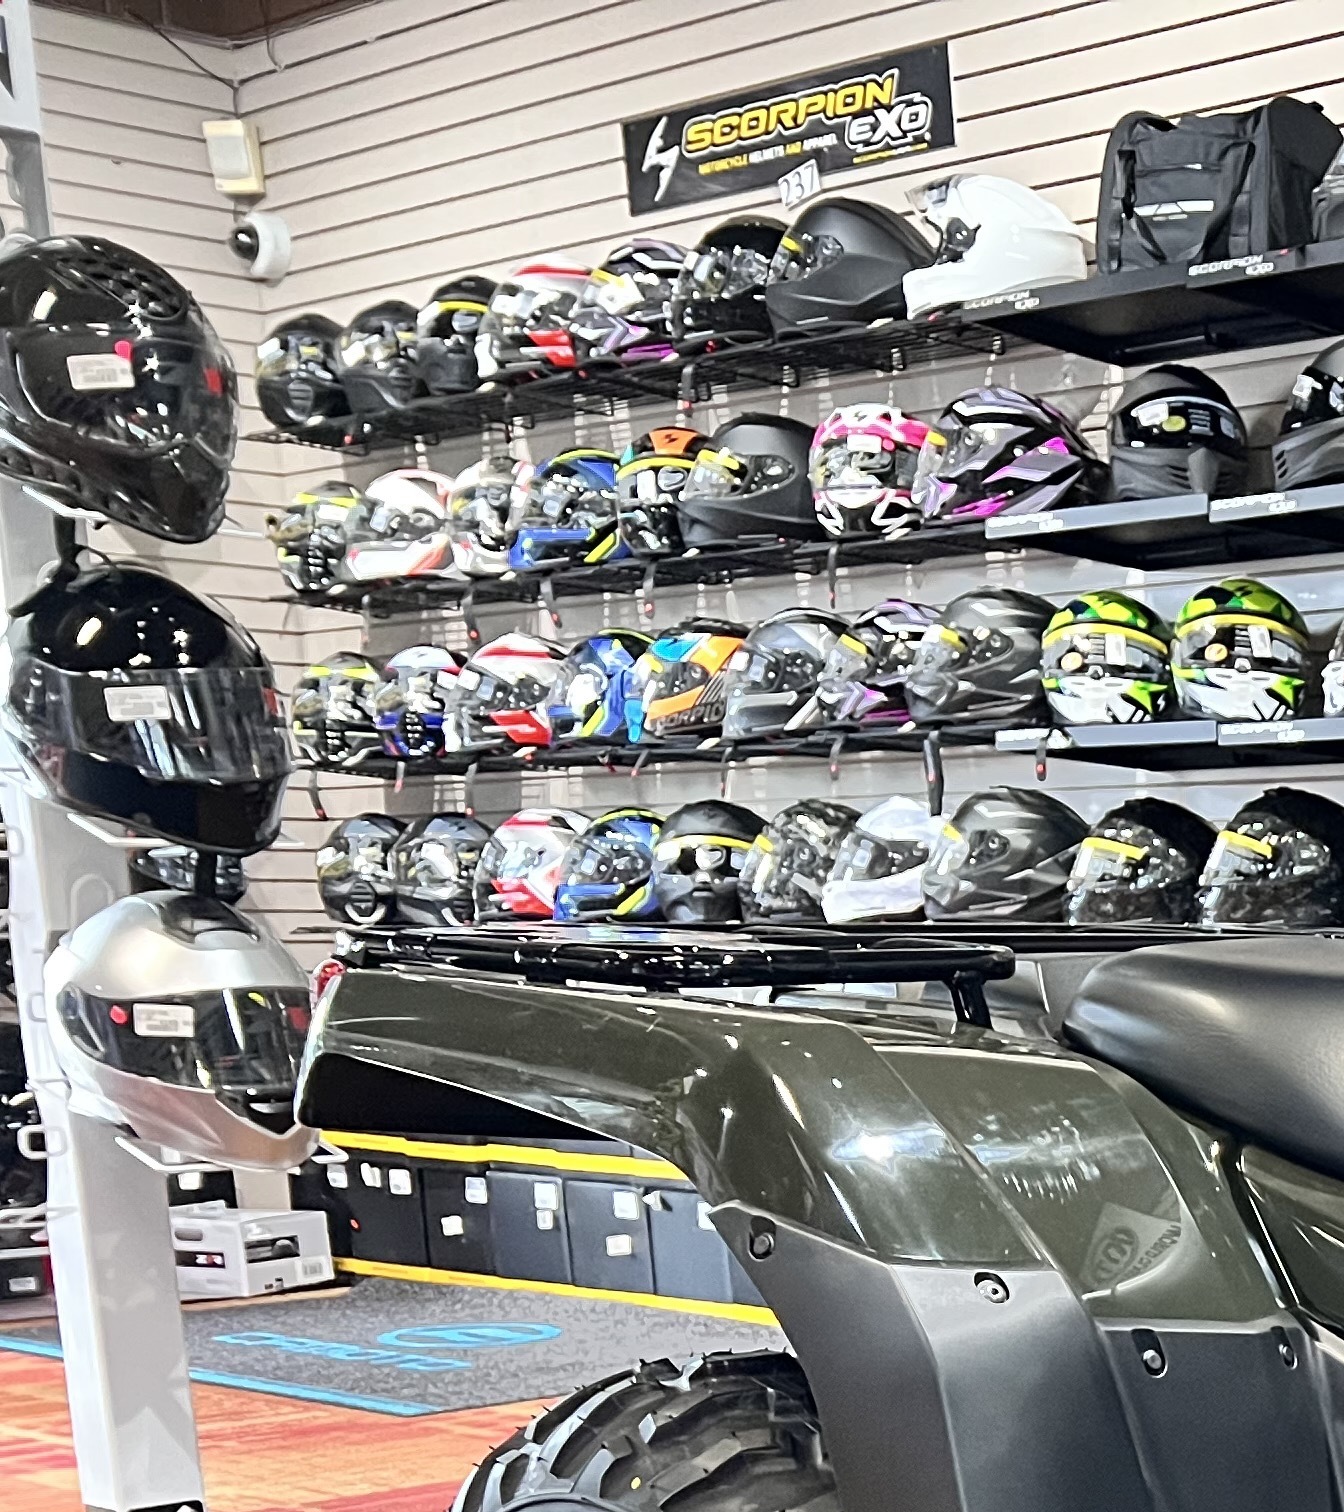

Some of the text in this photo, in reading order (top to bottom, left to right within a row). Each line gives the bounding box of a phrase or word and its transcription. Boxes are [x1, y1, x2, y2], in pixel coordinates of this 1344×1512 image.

[685, 76, 928, 151] SCORPION EXO
[782, 165, 816, 206] 237
